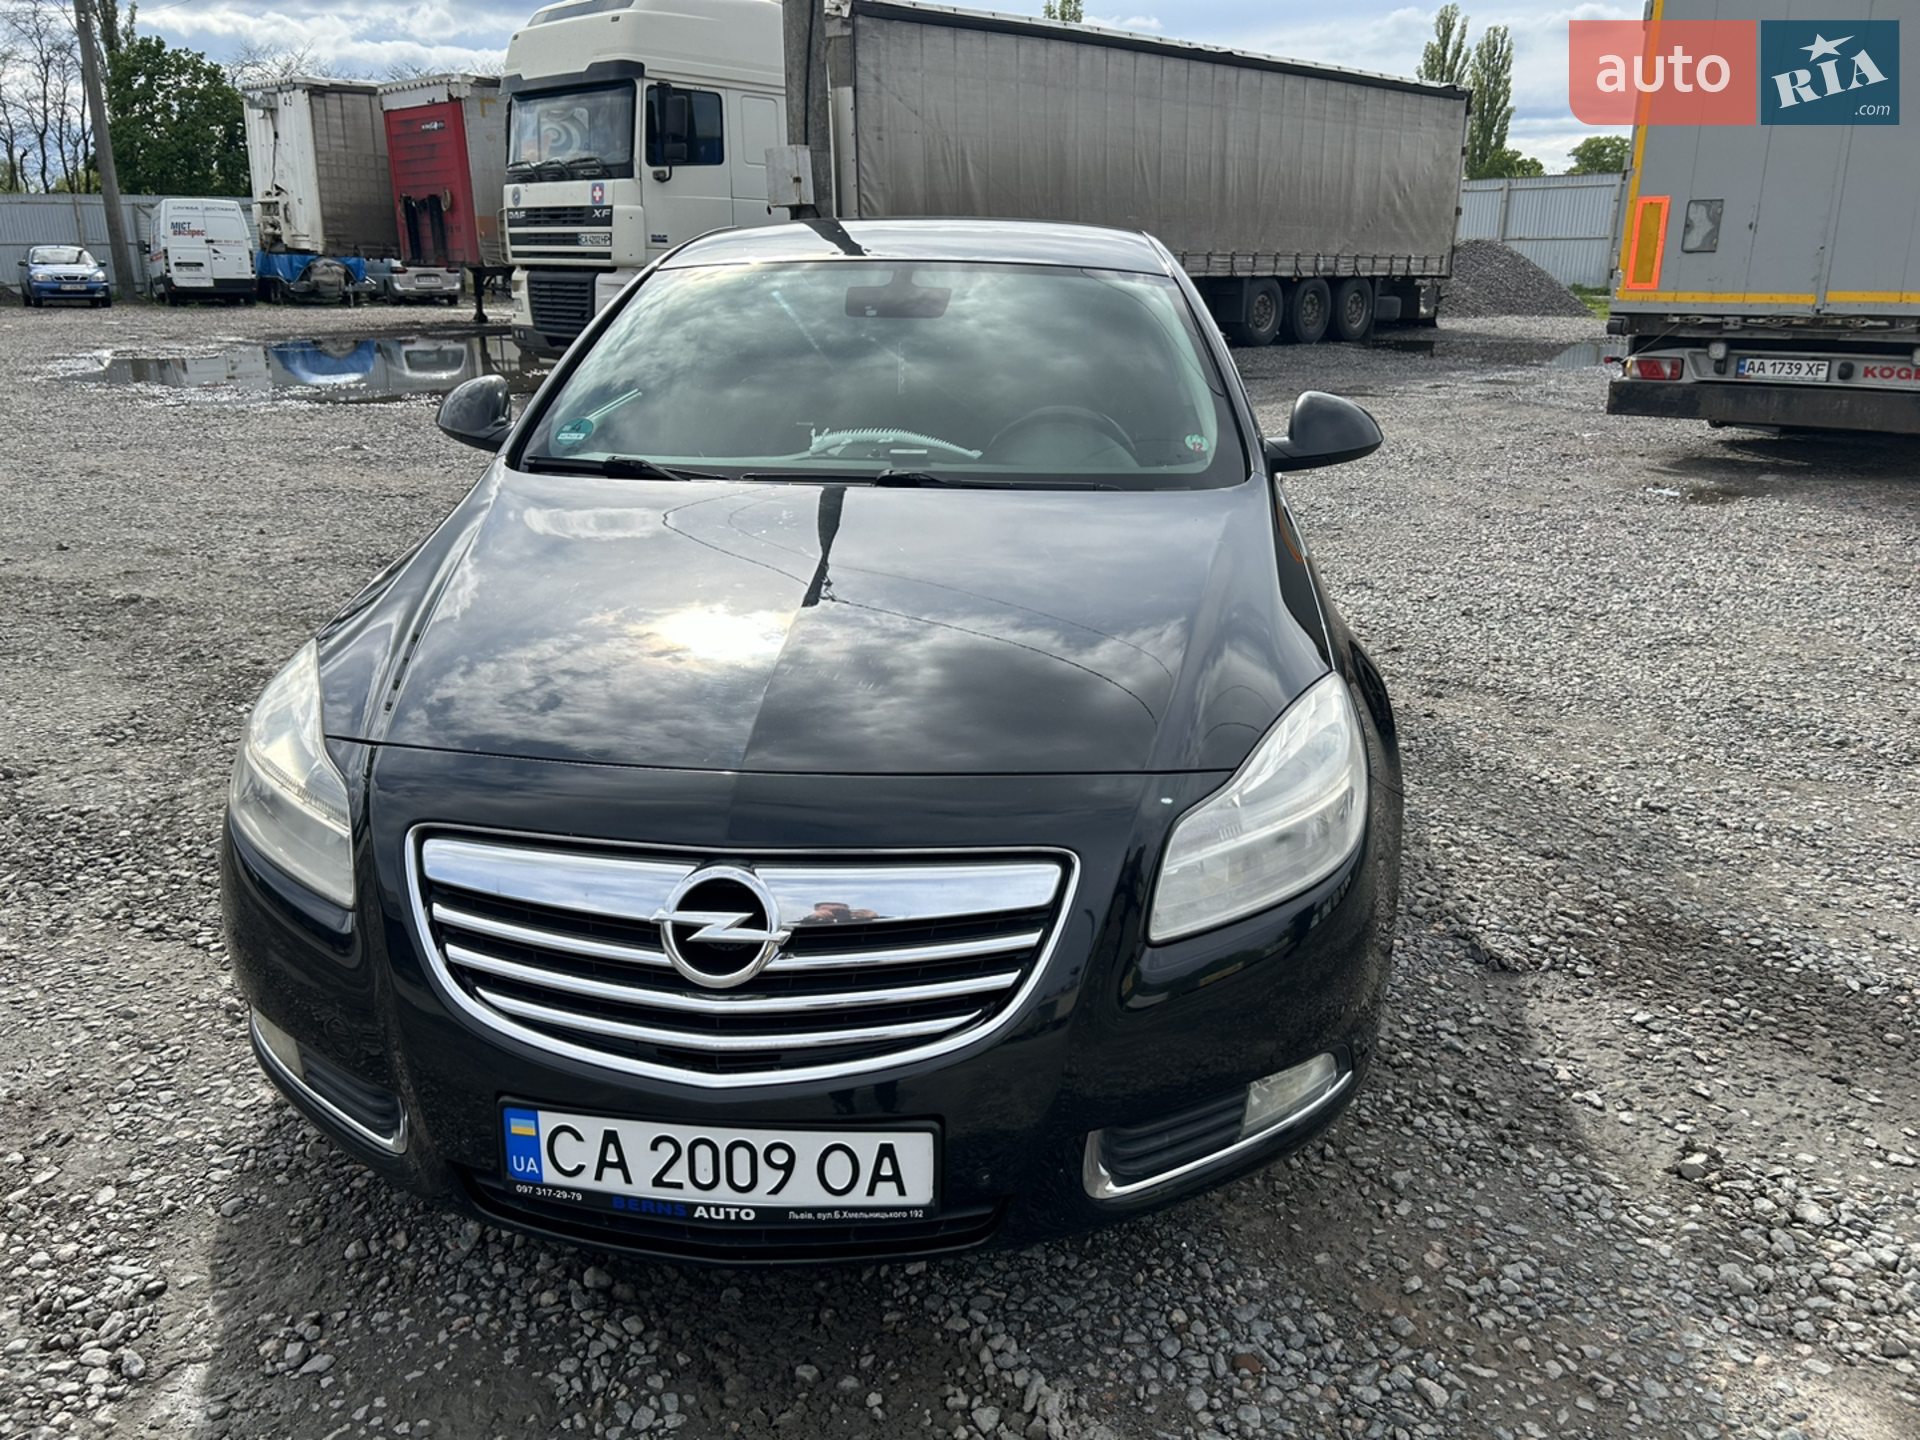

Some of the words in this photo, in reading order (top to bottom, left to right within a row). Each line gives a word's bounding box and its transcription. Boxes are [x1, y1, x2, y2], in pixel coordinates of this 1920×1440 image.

[508, 211, 526, 220] DAF
[592, 208, 612, 218] XF
[1746, 360, 1766, 374] AA
[1770, 361, 1802, 376] 1739
[1805, 363, 1827, 377] XF
[512, 1154, 540, 1175] UA
[546, 1123, 634, 1186] CA
[649, 1134, 797, 1196] 2009
[816, 1141, 908, 1197] OA
[516, 1184, 533, 1195] 097
[535, 1186, 583, 1202] 317-29-79
[612, 1195, 687, 1217] BERNS
[693, 1205, 757, 1222] AUTO
[788, 1210, 816, 1221] Львів,
[909, 1209, 924, 1218] 192
